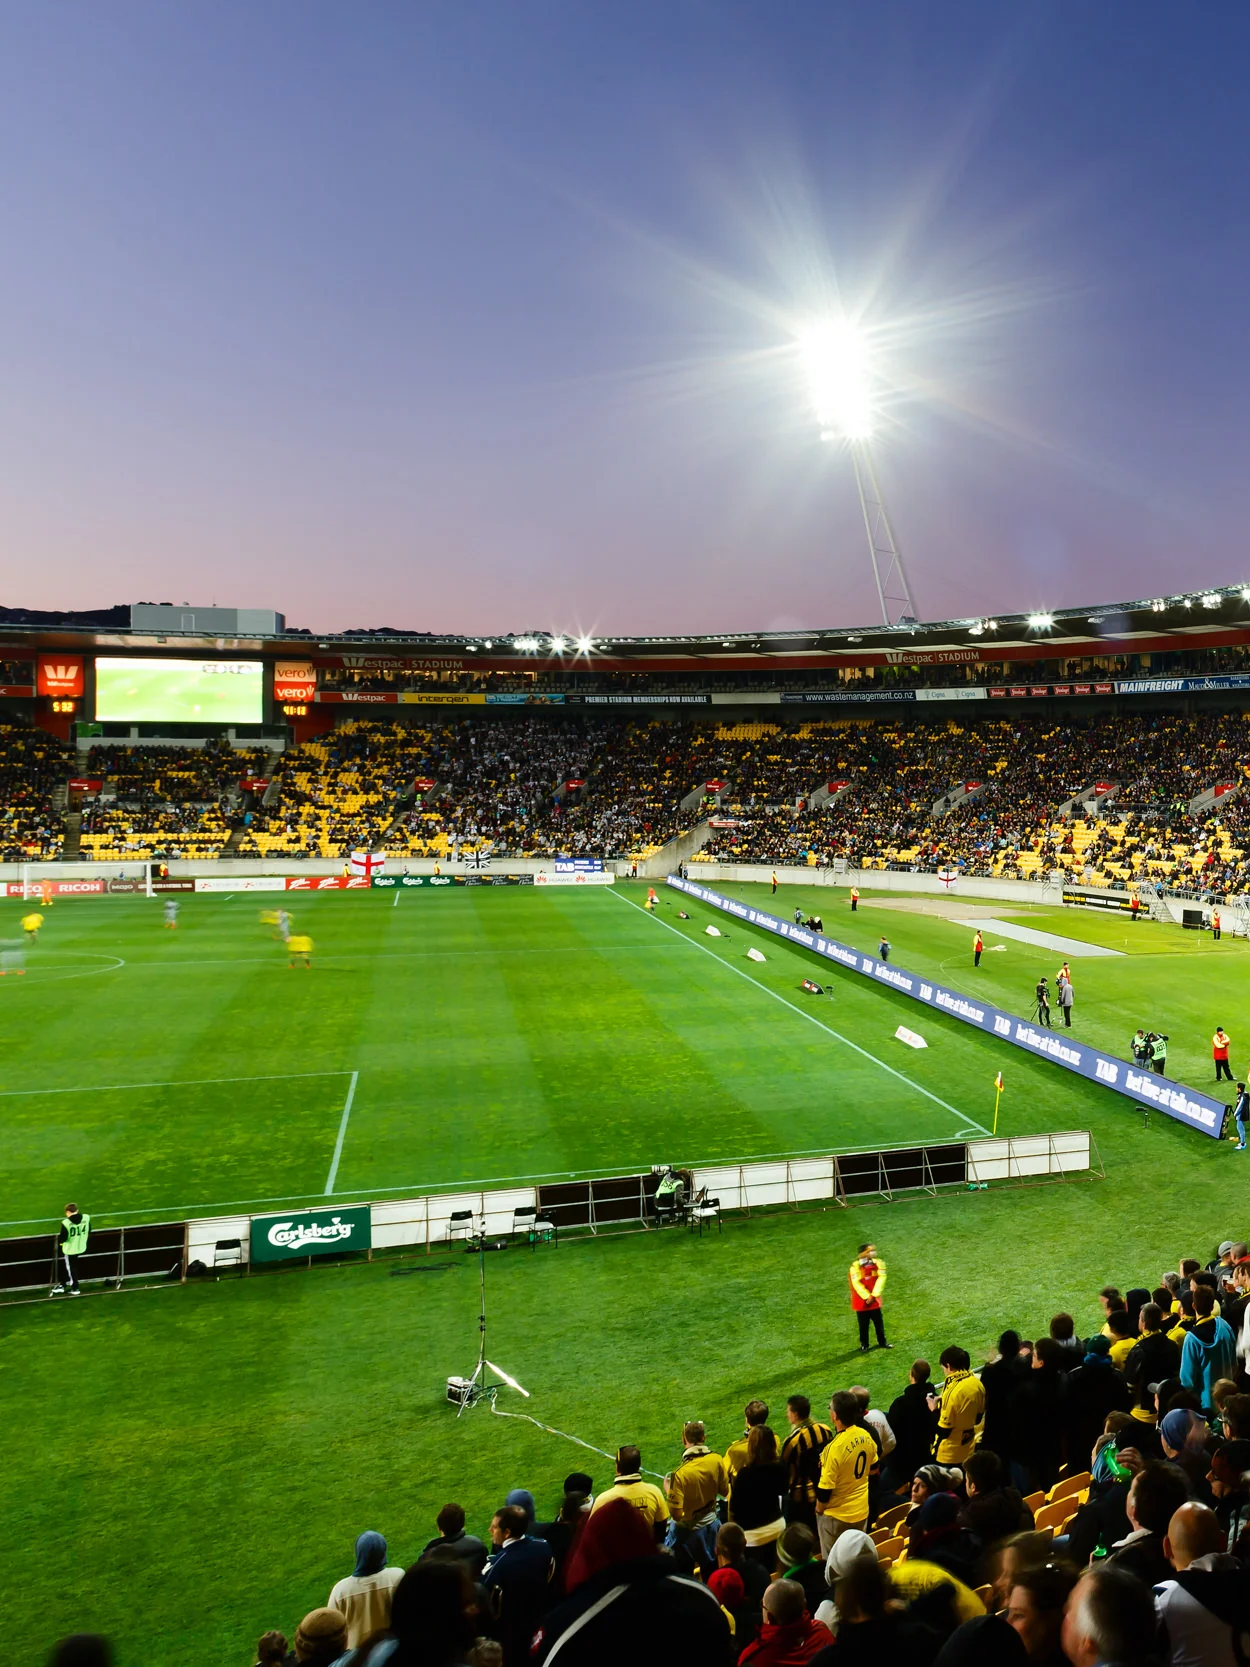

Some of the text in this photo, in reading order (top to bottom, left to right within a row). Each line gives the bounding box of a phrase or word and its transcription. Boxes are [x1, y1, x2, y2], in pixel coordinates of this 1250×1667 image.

[343, 657, 463, 669] Westpac STADIUM
[885, 652, 980, 665] Westpac STADIUM
[277, 669, 306, 678] vero
[1120, 680, 1184, 693] MAINFREIGHT
[277, 688, 306, 698] vero
[342, 693, 386, 702] Westpac
[806, 691, 914, 703] www.wastemanagement.co.nz
[418, 694, 469, 704] intergen
[555, 863, 574, 871] TAB
[10, 885, 43, 893] RICO
[58, 884, 100, 892] RICOH
[1096, 1058, 1118, 1083] TAB
[268, 1217, 355, 1249] Carlsberg
[854, 1450, 867, 1480] 0
